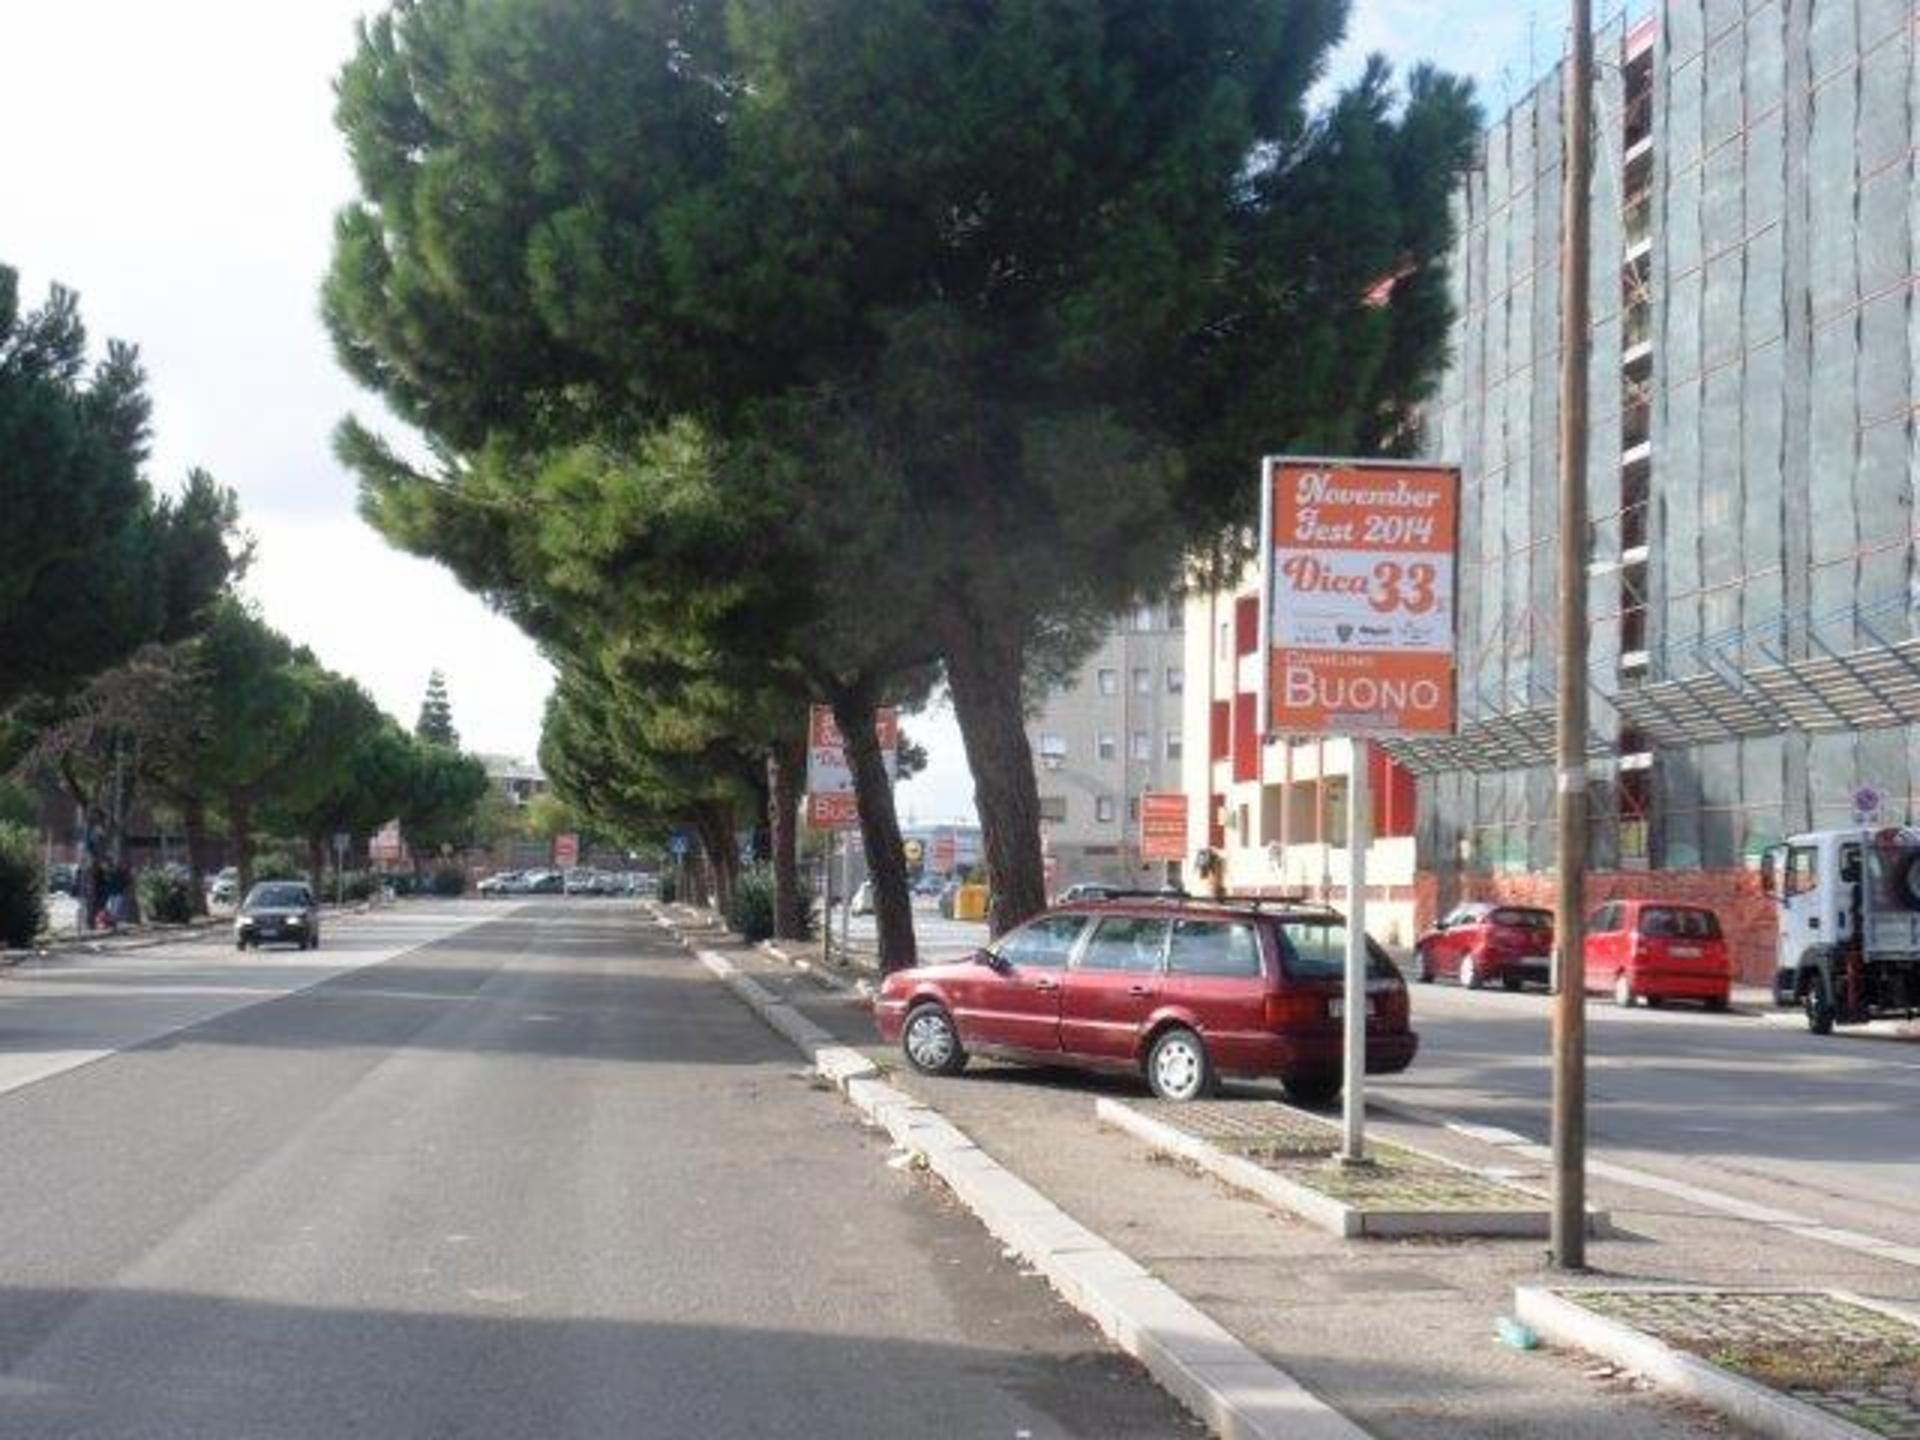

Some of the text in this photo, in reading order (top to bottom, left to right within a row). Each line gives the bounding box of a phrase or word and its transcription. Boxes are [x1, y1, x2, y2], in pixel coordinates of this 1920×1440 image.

[1296, 473, 1440, 507] November
[1296, 507, 1434, 544] Fest 2014
[1285, 667, 1438, 709] BUONO
